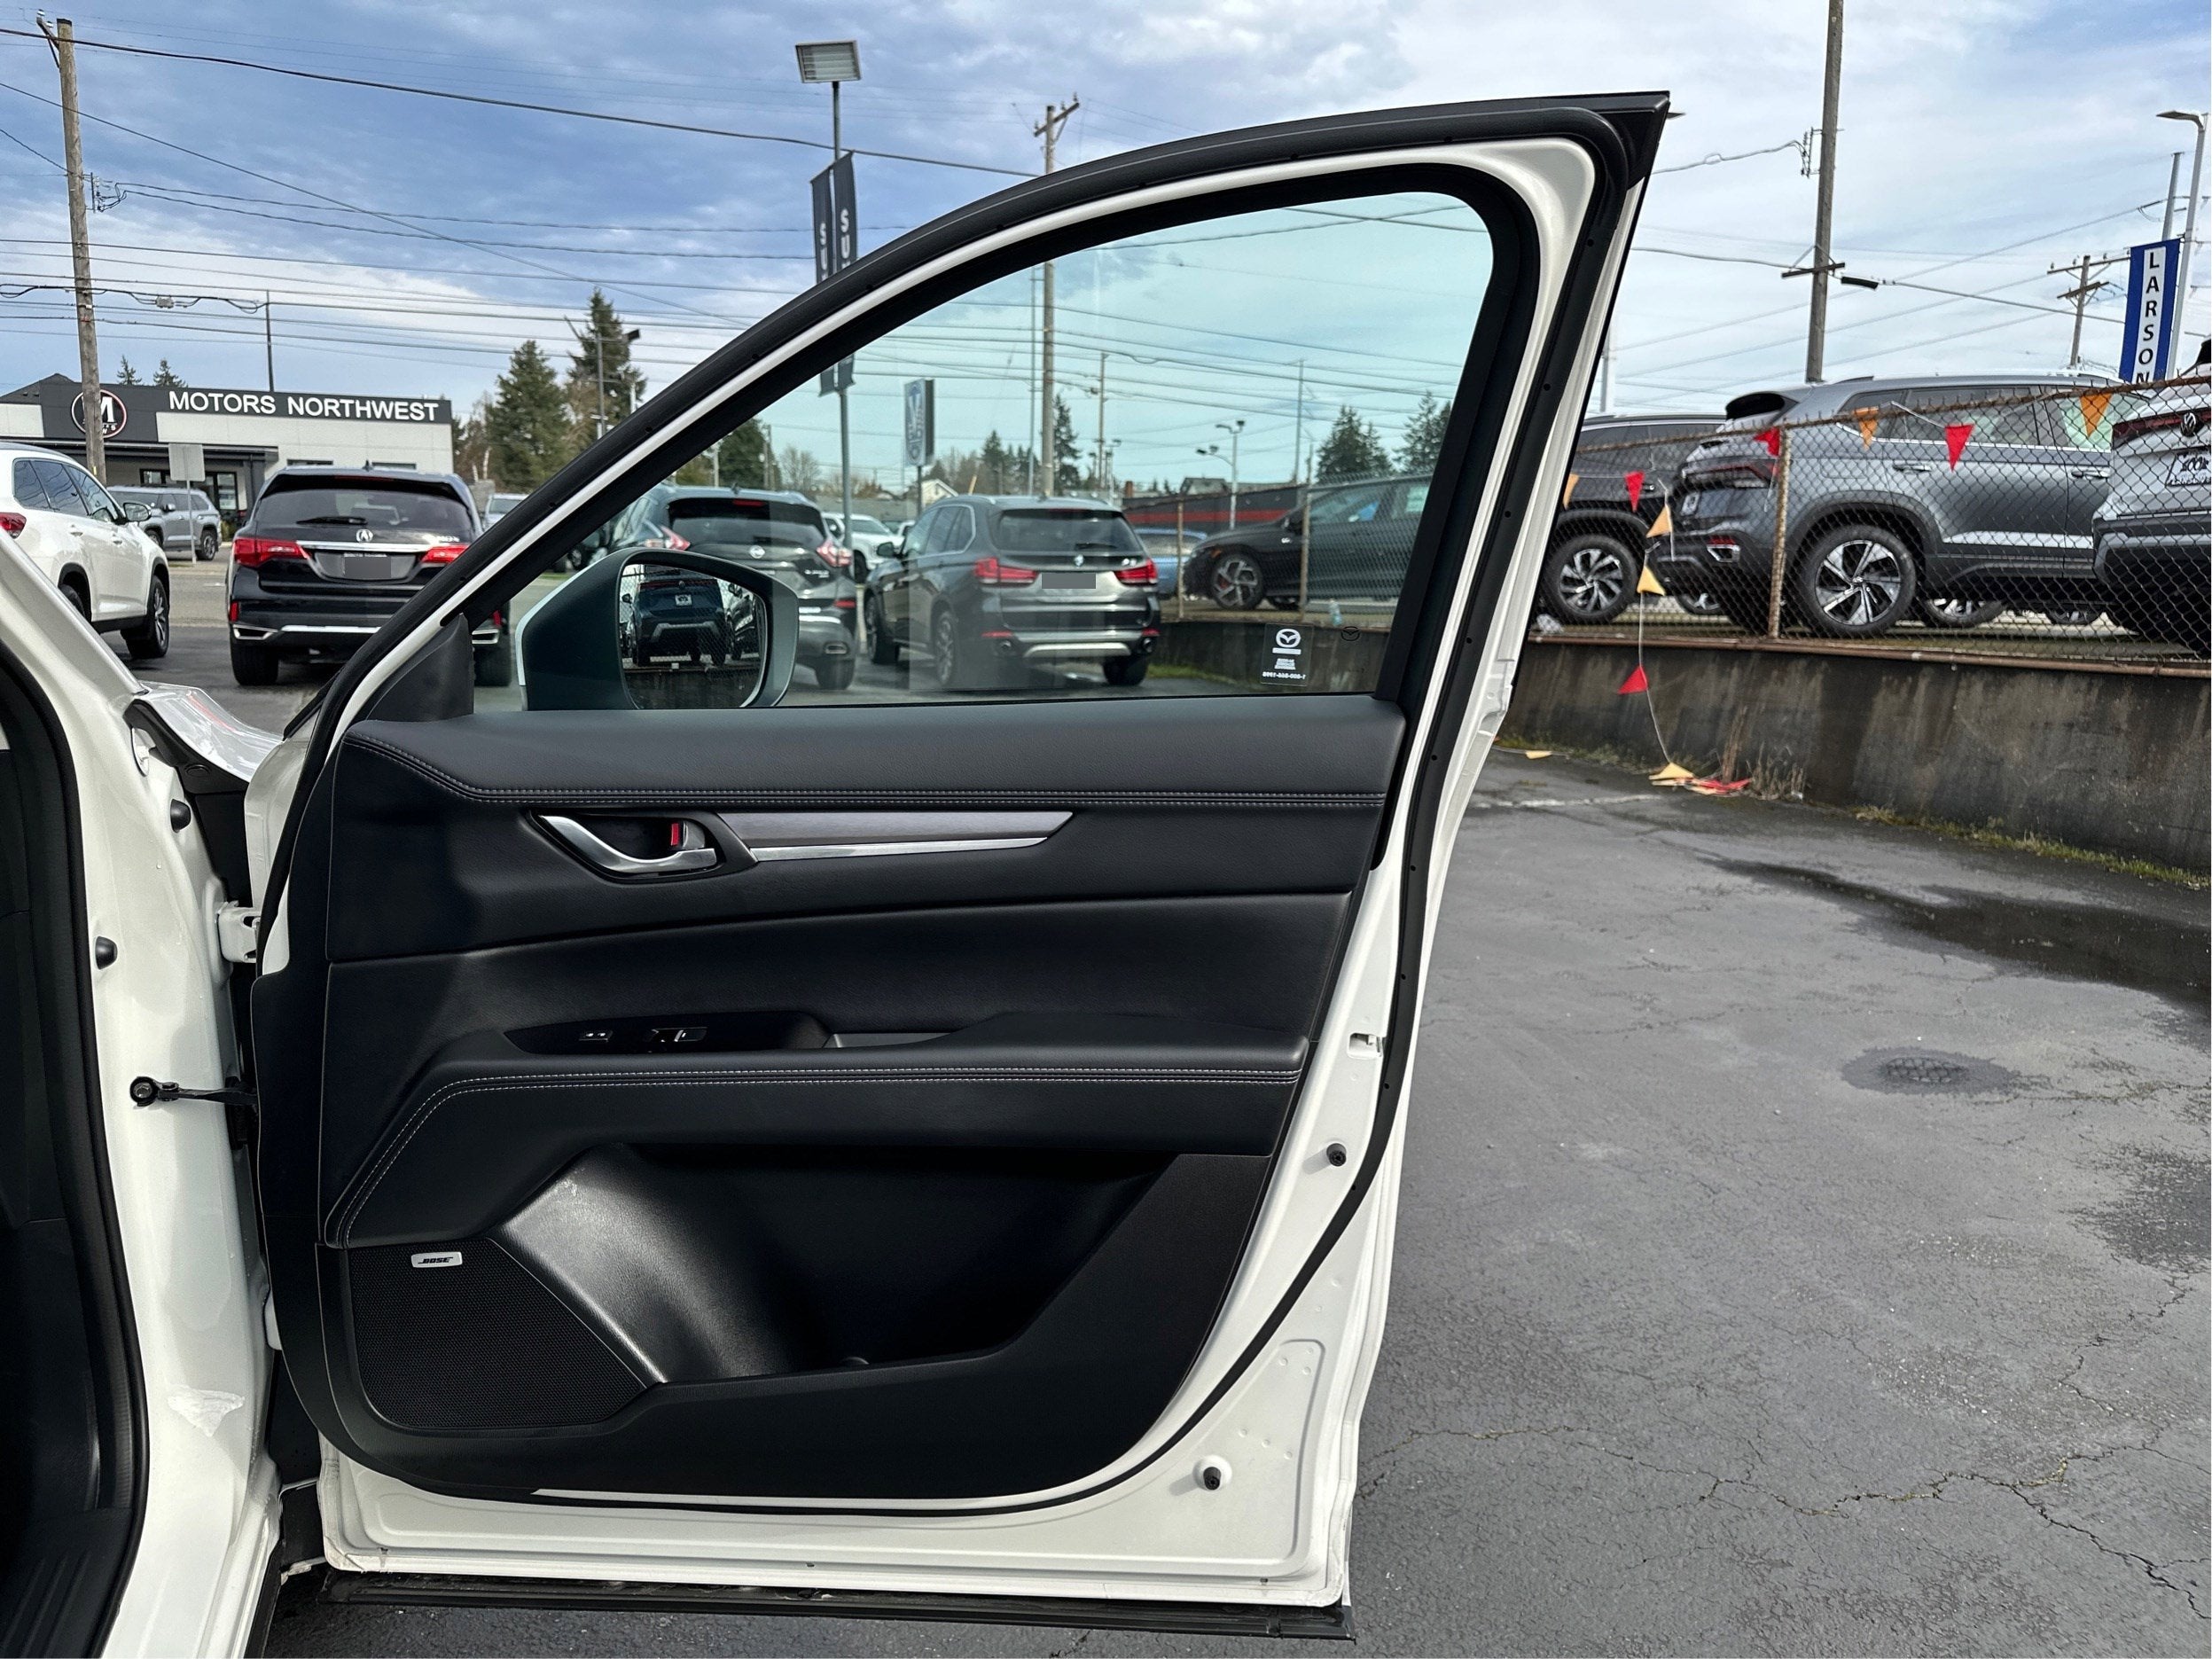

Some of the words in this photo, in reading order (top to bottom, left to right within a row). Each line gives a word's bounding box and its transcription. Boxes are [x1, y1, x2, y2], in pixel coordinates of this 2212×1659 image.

[819, 222, 828, 281] SU
[840, 208, 851, 269] SU
[2136, 252, 2160, 383] LARSON
[168, 390, 277, 414] MOTORS
[288, 396, 439, 421] NORTHWEST
